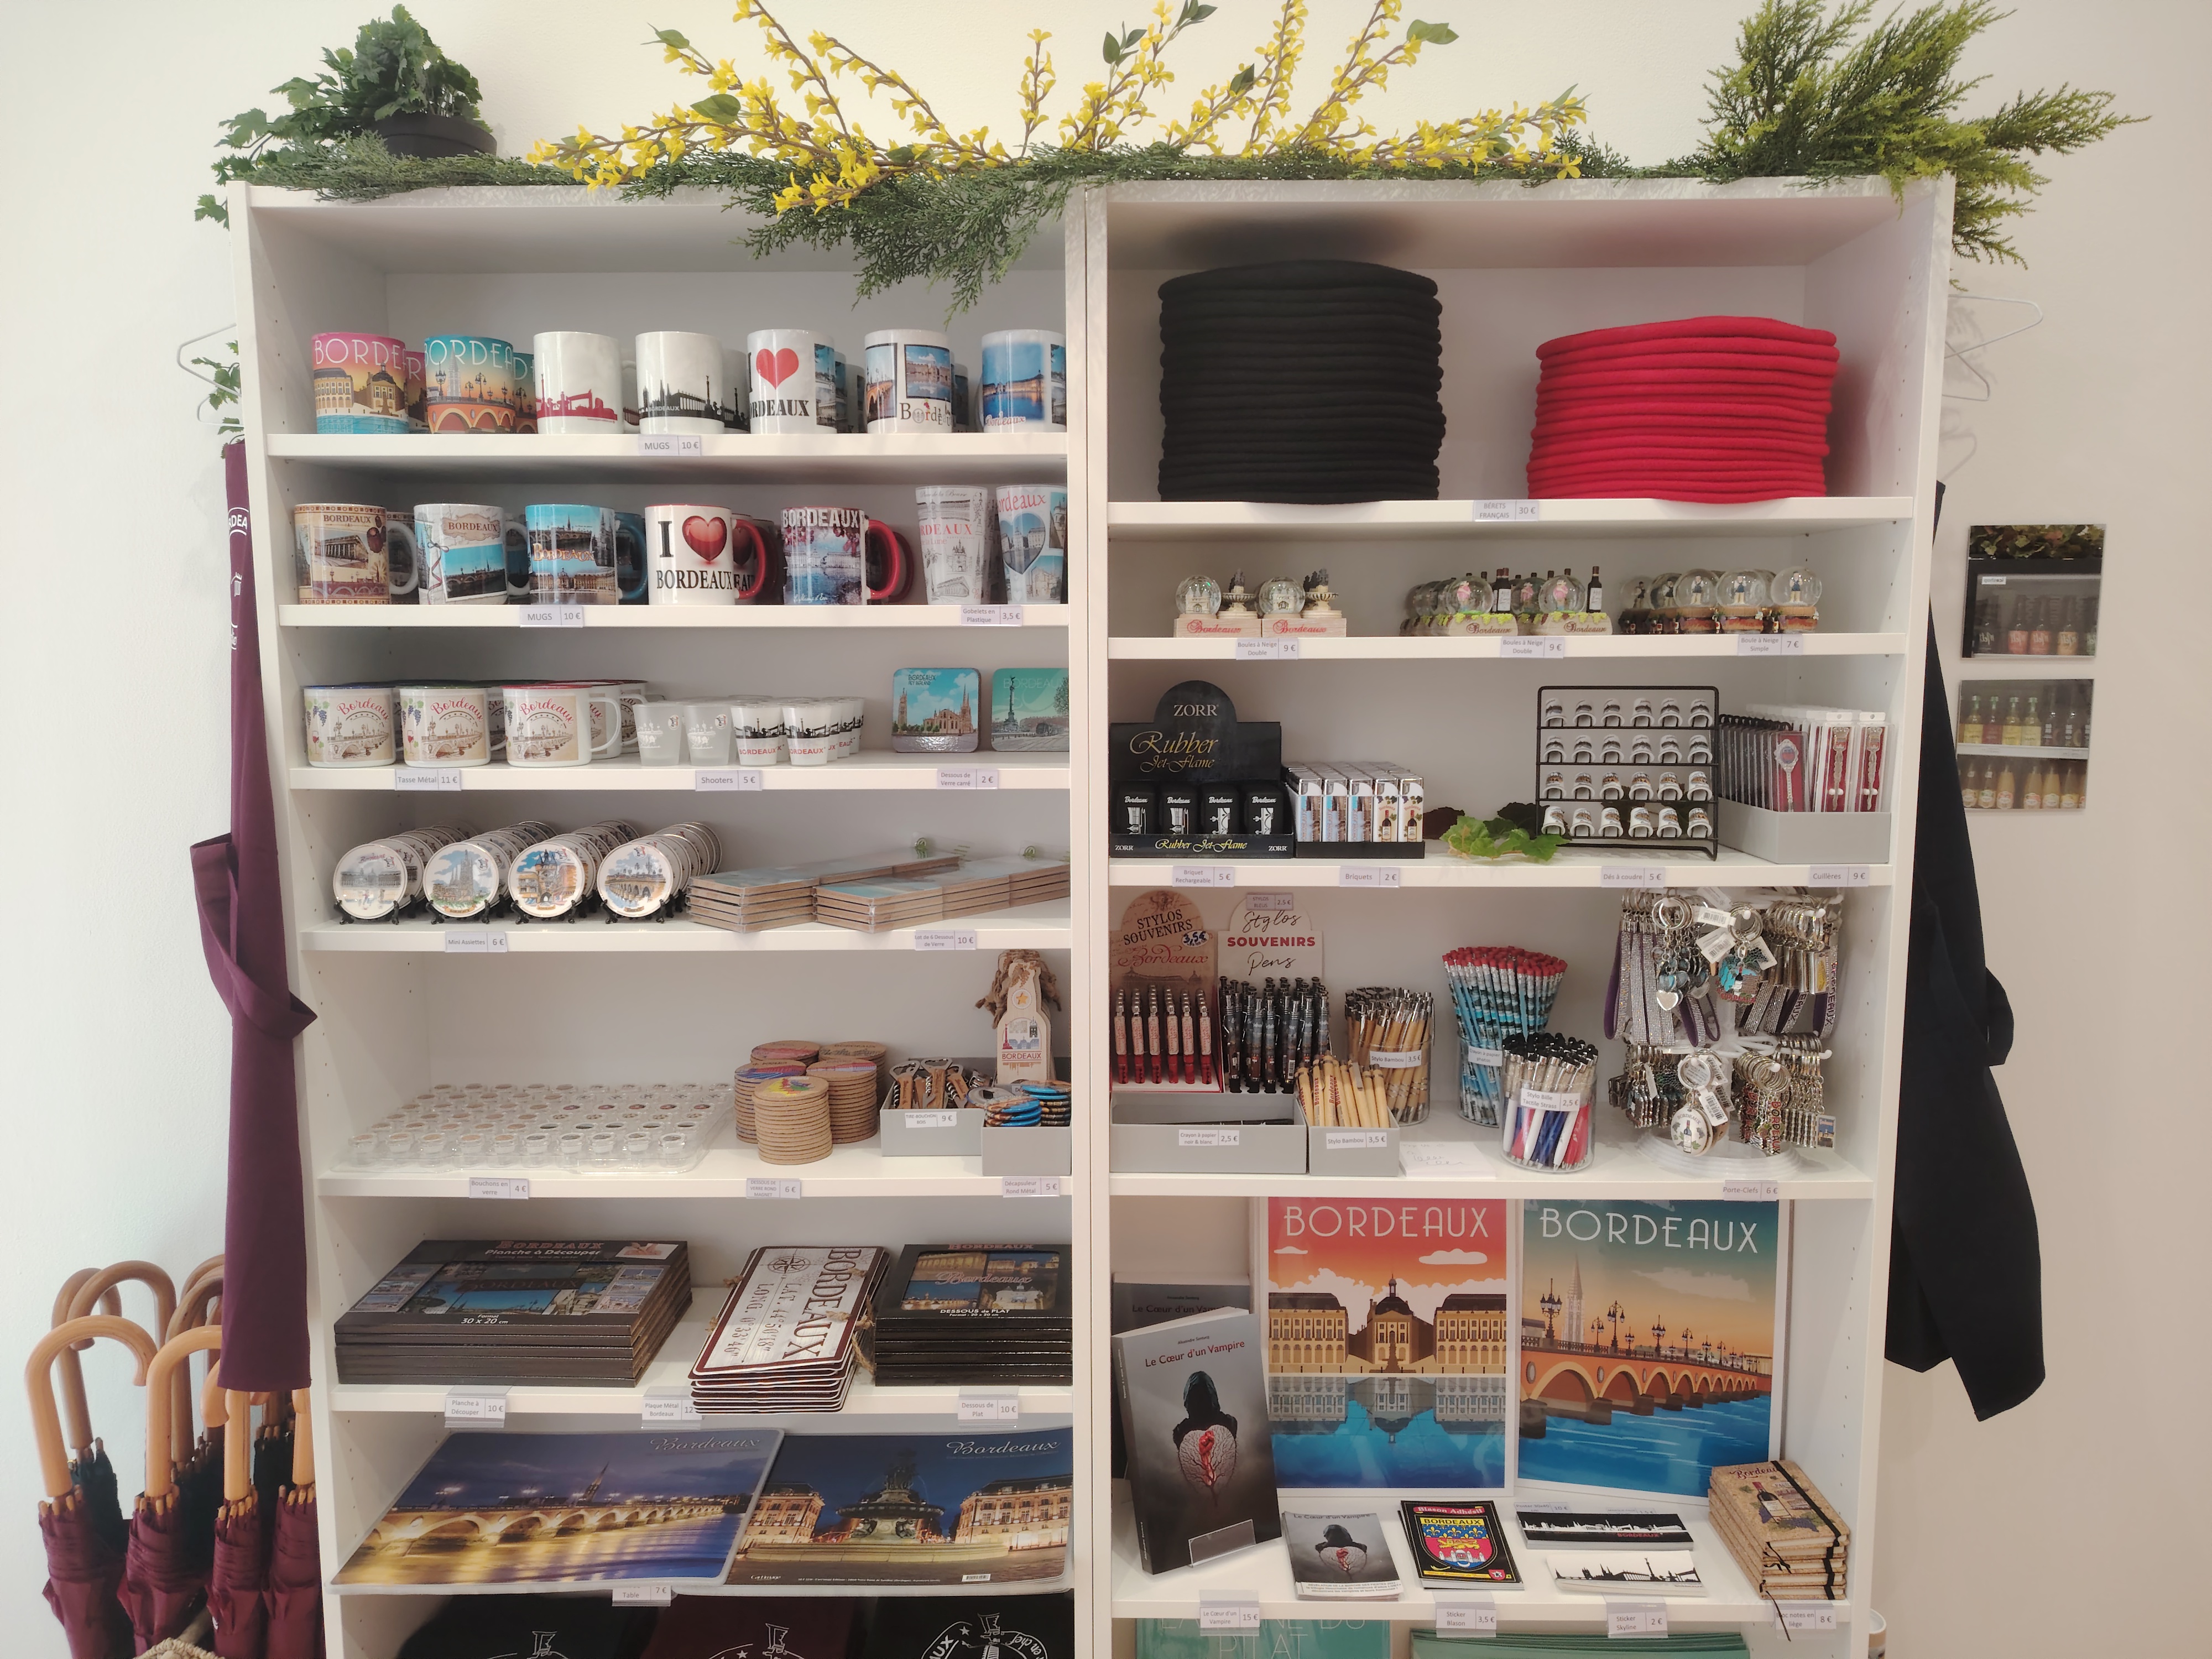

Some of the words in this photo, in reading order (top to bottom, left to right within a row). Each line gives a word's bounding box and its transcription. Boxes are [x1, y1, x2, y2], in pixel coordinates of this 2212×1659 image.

[644, 441, 670, 451] MUGS
[682, 441, 692, 450] 10
[693, 441, 699, 450] €
[323, 514, 371, 524] BORDEAUX
[782, 509, 860, 528] BORDEAUX
[448, 522, 499, 533] BORDEAUX
[658, 521, 674, 558] I
[656, 570, 733, 590] BORDEAUX
[527, 613, 552, 621] MUGS
[1002, 612, 1014, 620] 3,5
[1187, 619, 1241, 634] Bordeaux
[1272, 619, 1327, 634] Bordeaux
[1466, 623, 1512, 635] Bordeaux
[1563, 621, 1607, 633] Bordeaux
[430, 697, 483, 723] Bordeaux
[519, 698, 574, 724] Bordeaux
[1173, 704, 1218, 717] ZORR
[1129, 731, 1219, 754] Rubber
[418, 775, 437, 783] Métal
[1154, 838, 1192, 850] Rubber
[1813, 871, 1841, 880] Cuillères
[1137, 909, 1183, 930] STYLOS
[1242, 910, 1302, 933] Stylos
[1123, 919, 1193, 946] SOUVENIRS
[1227, 936, 1316, 947] SOUVENIRS
[1118, 944, 1208, 967] Bordeaux
[1248, 951, 1297, 976] Pens
[1407, 1054, 1417, 1063] 3,5
[1526, 1092, 1540, 1100] Stylo
[1562, 1099, 1573, 1107] 2,5
[1771, 1101, 1781, 1155] BORDEAUX
[1723, 1186, 1759, 1194] Porte-Clefs
[1284, 1206, 1489, 1238] BORDEAUX
[1540, 1208, 1758, 1254] BORDEAUX
[935, 1272, 1033, 1286] Bordeaux
[782, 1249, 863, 1360] BORDEAUX
[1145, 1358, 1157, 1368] Le
[1159, 1353, 1185, 1364] Cœur
[1187, 1349, 1207, 1359] d'un
[1207, 1340, 1245, 1354] Vampire
[1000, 1405, 1010, 1413] 10
[650, 1437, 760, 1451] Bordeaux
[946, 1441, 1061, 1455] Bordeaux
